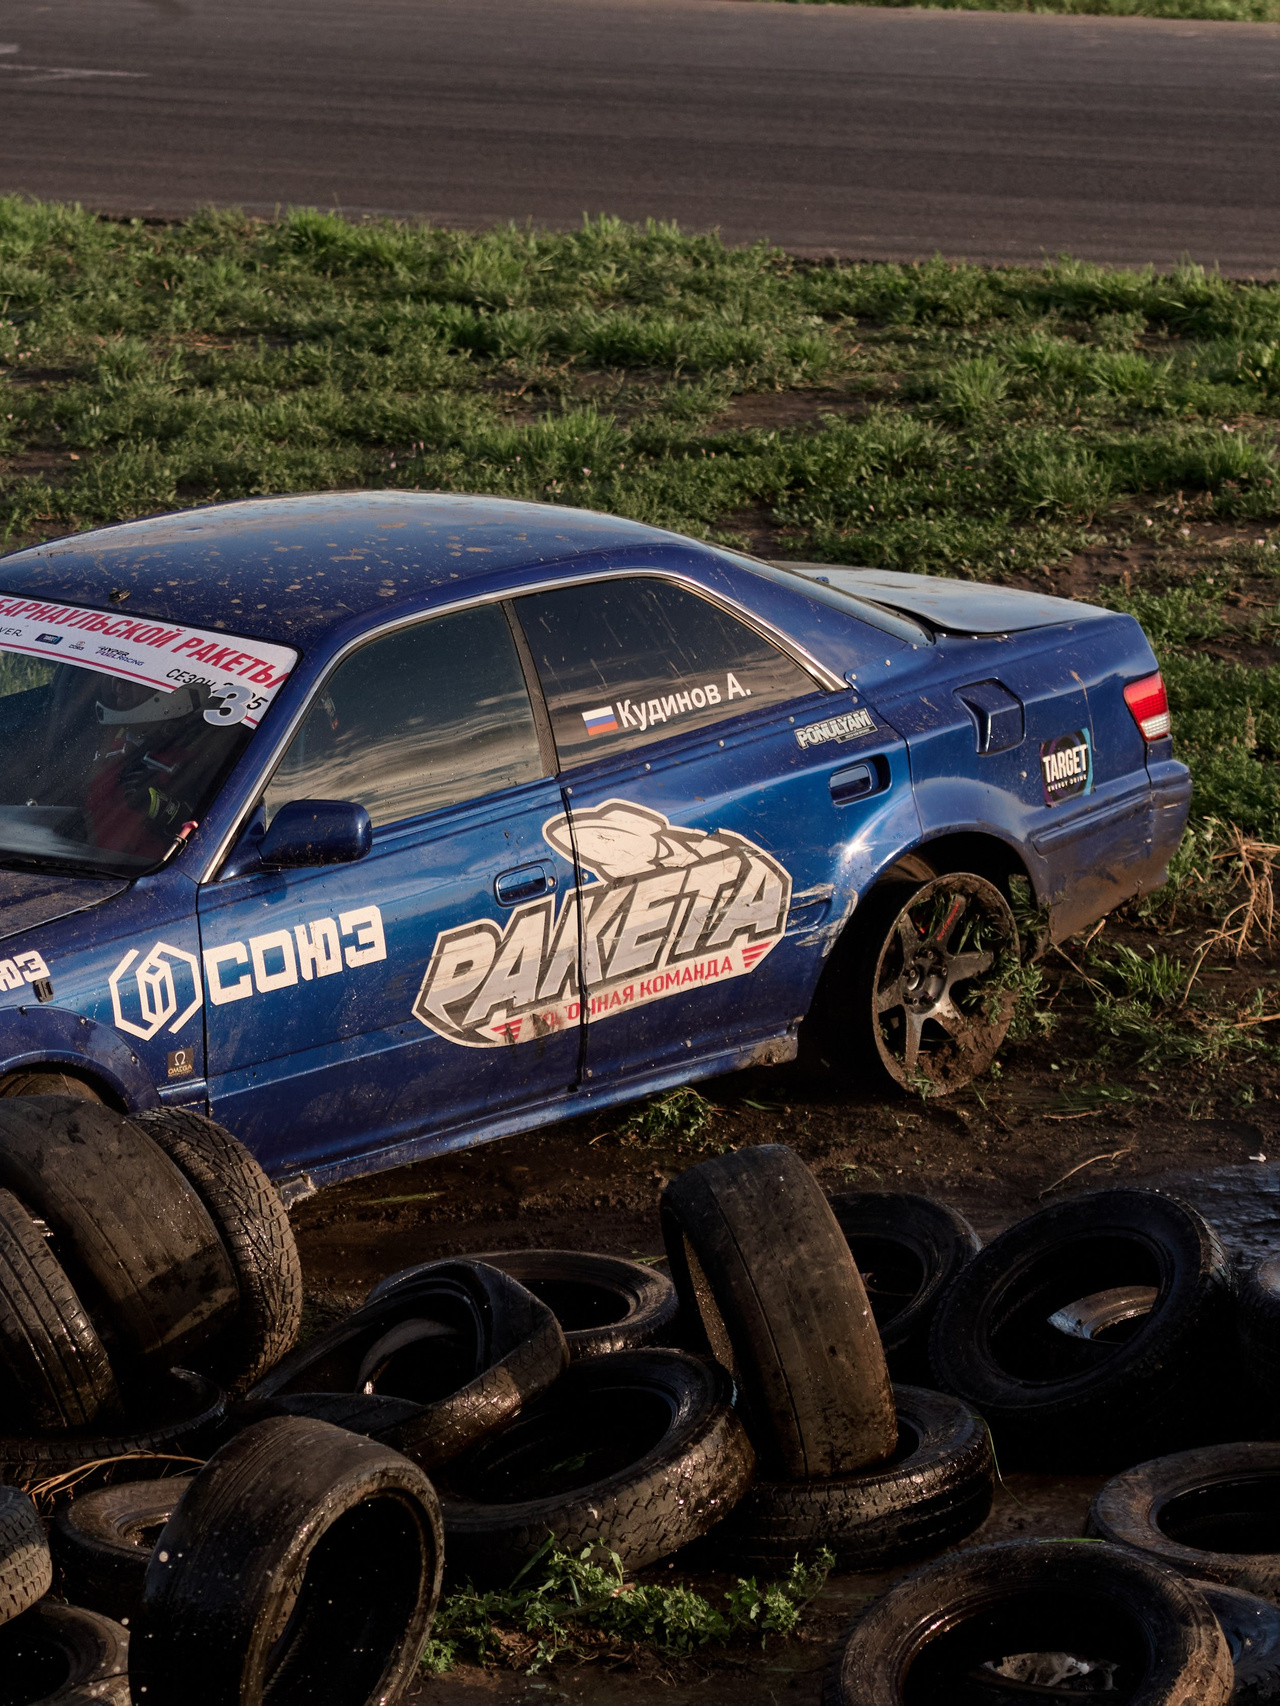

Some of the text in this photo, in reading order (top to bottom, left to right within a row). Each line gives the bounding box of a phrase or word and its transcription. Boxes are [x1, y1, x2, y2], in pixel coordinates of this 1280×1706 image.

[170, 637, 291, 690] РАКЕТЫ
[203, 685, 254, 727] 3
[616, 672, 753, 732] Кудинов А.
[796, 709, 873, 749] PONULYAM
[1042, 743, 1089, 783] TARGET
[201, 905, 388, 1006] СОЮЗ
[422, 853, 784, 1032] РАКЕТА
[639, 955, 734, 999] КОМАНДА
